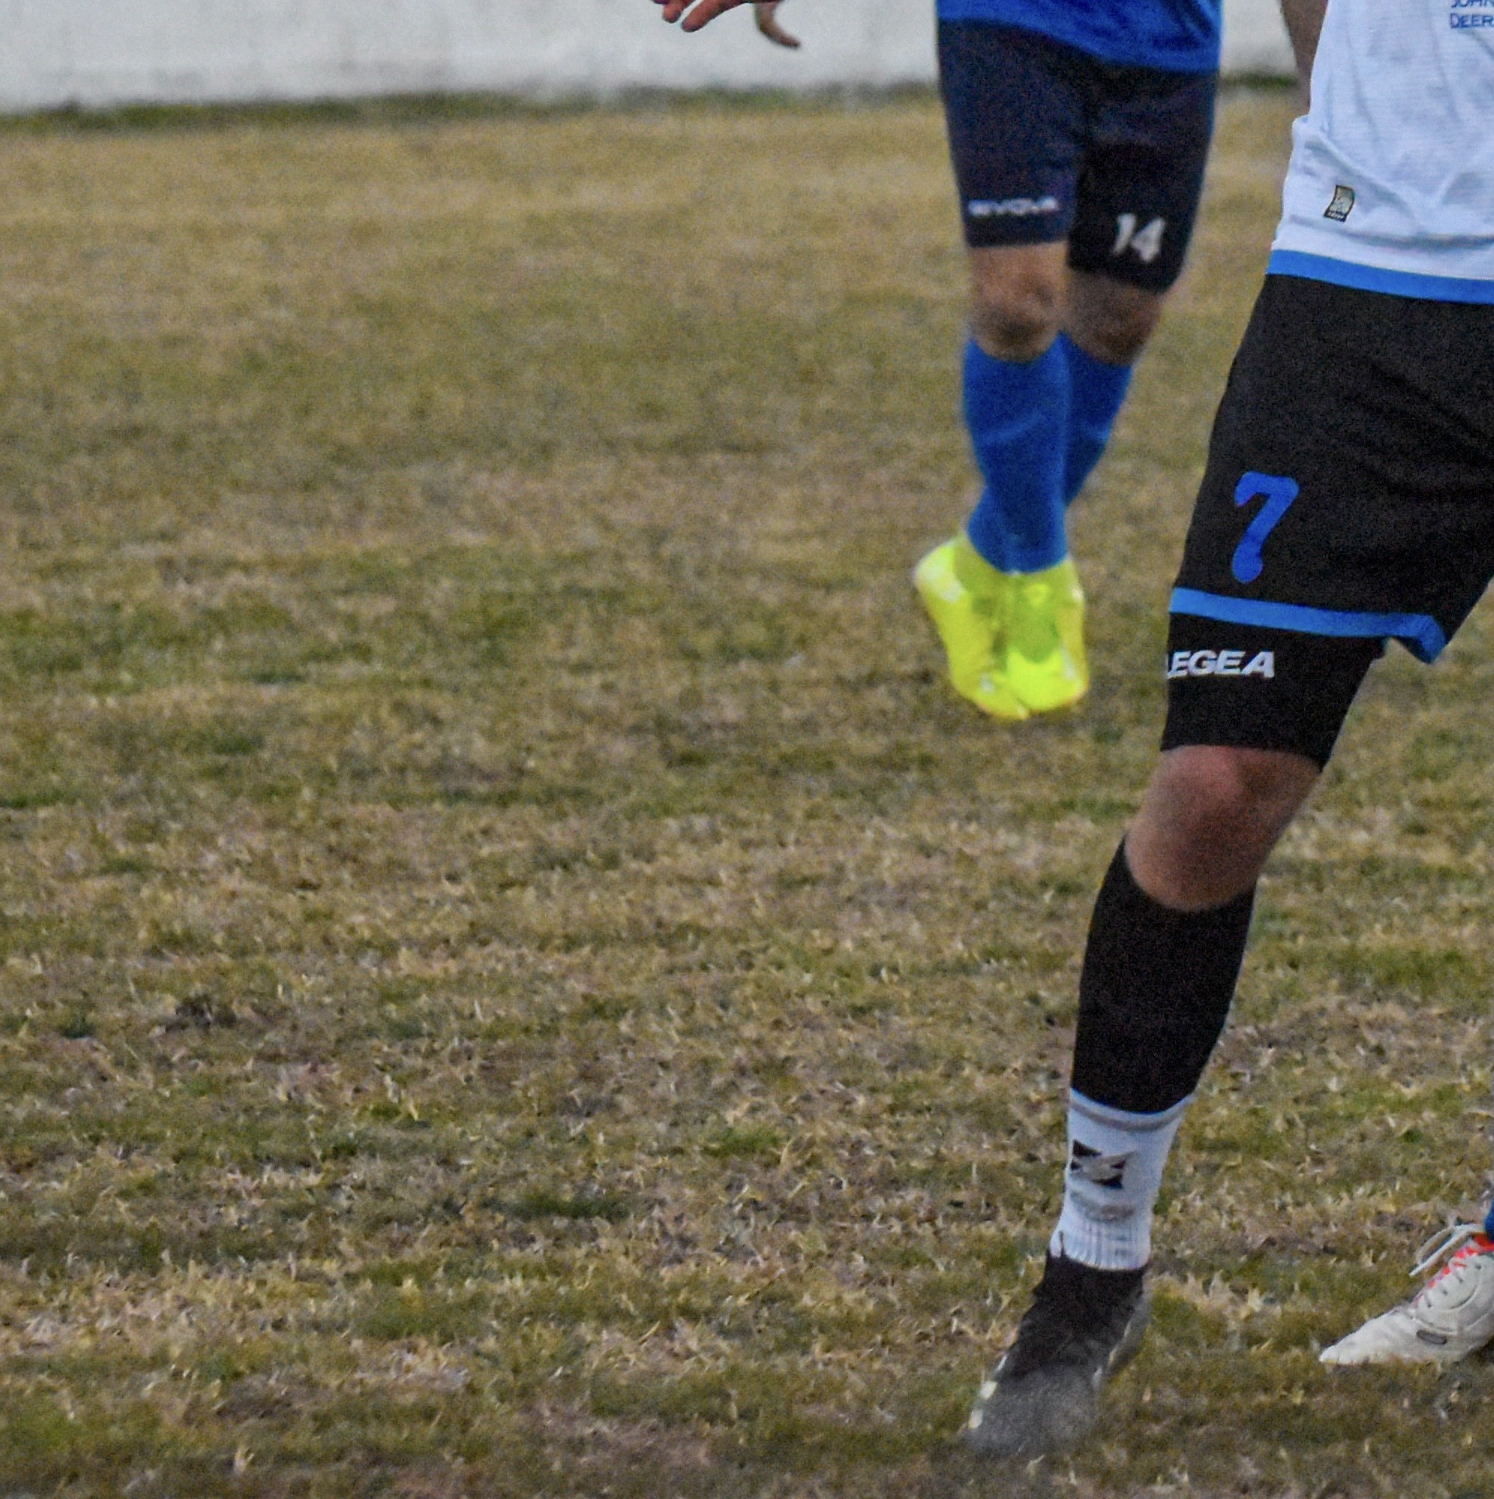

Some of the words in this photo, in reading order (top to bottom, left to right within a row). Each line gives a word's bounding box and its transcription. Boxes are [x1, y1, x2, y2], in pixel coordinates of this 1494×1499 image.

[1113, 213, 1166, 263] 14
[1231, 470, 1300, 580] 7
[1167, 650, 1275, 679] EGEA
